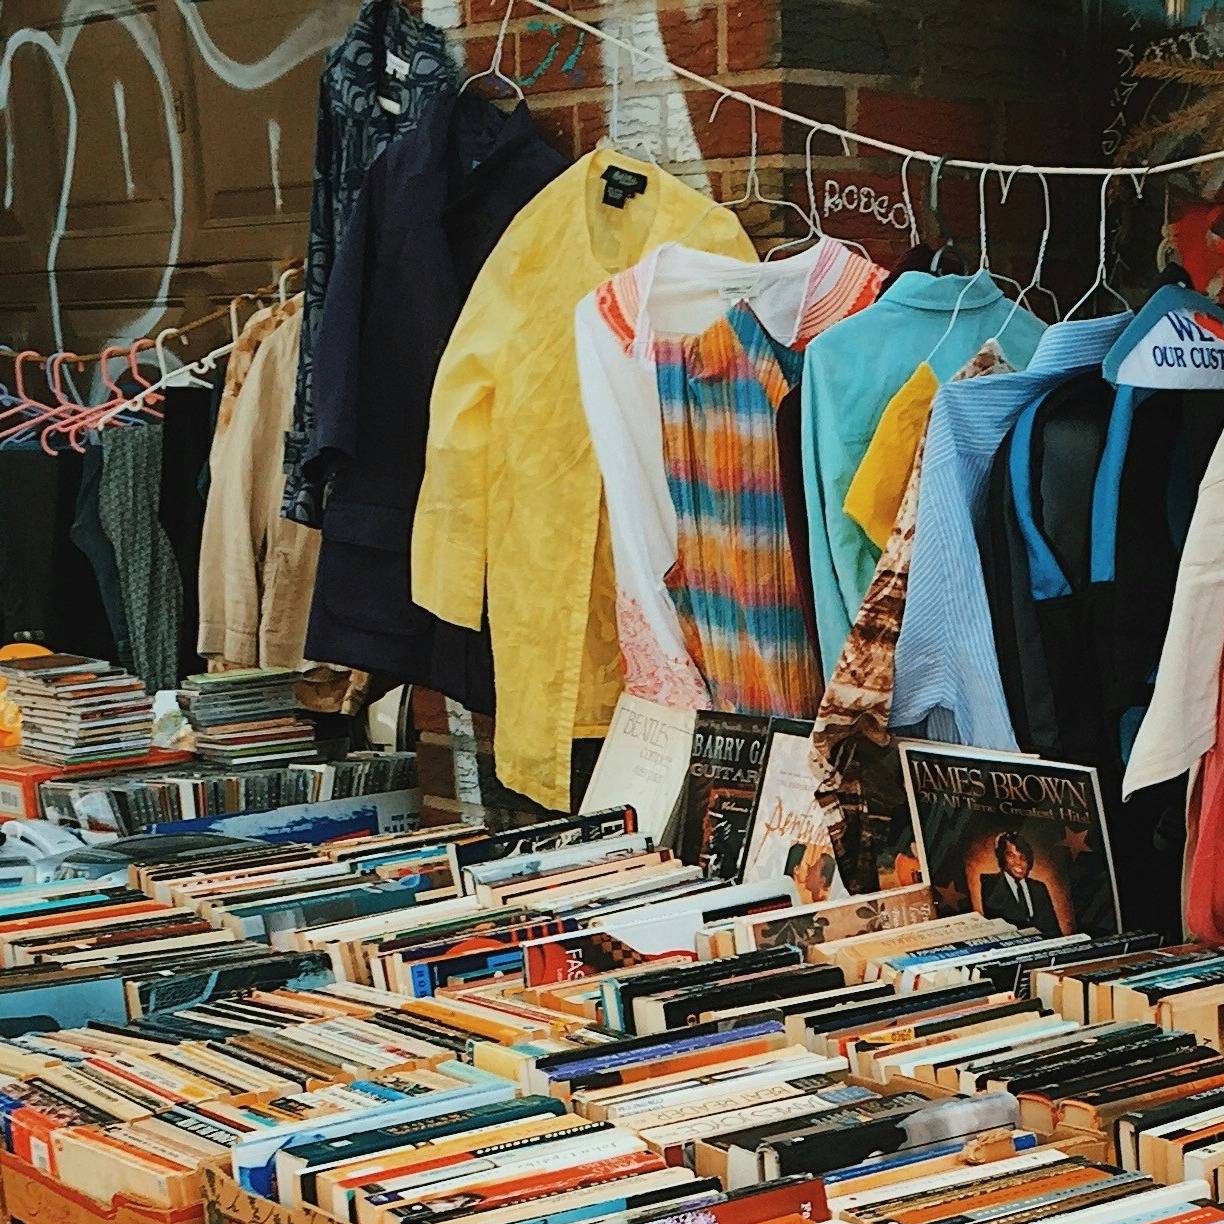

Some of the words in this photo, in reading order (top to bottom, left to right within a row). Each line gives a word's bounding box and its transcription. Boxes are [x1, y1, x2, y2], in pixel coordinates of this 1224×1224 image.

[1152, 346, 1187, 368] OUR
[692, 733, 746, 764] BARRY
[911, 760, 986, 798] JAMES
[989, 771, 1088, 810] BROWN
